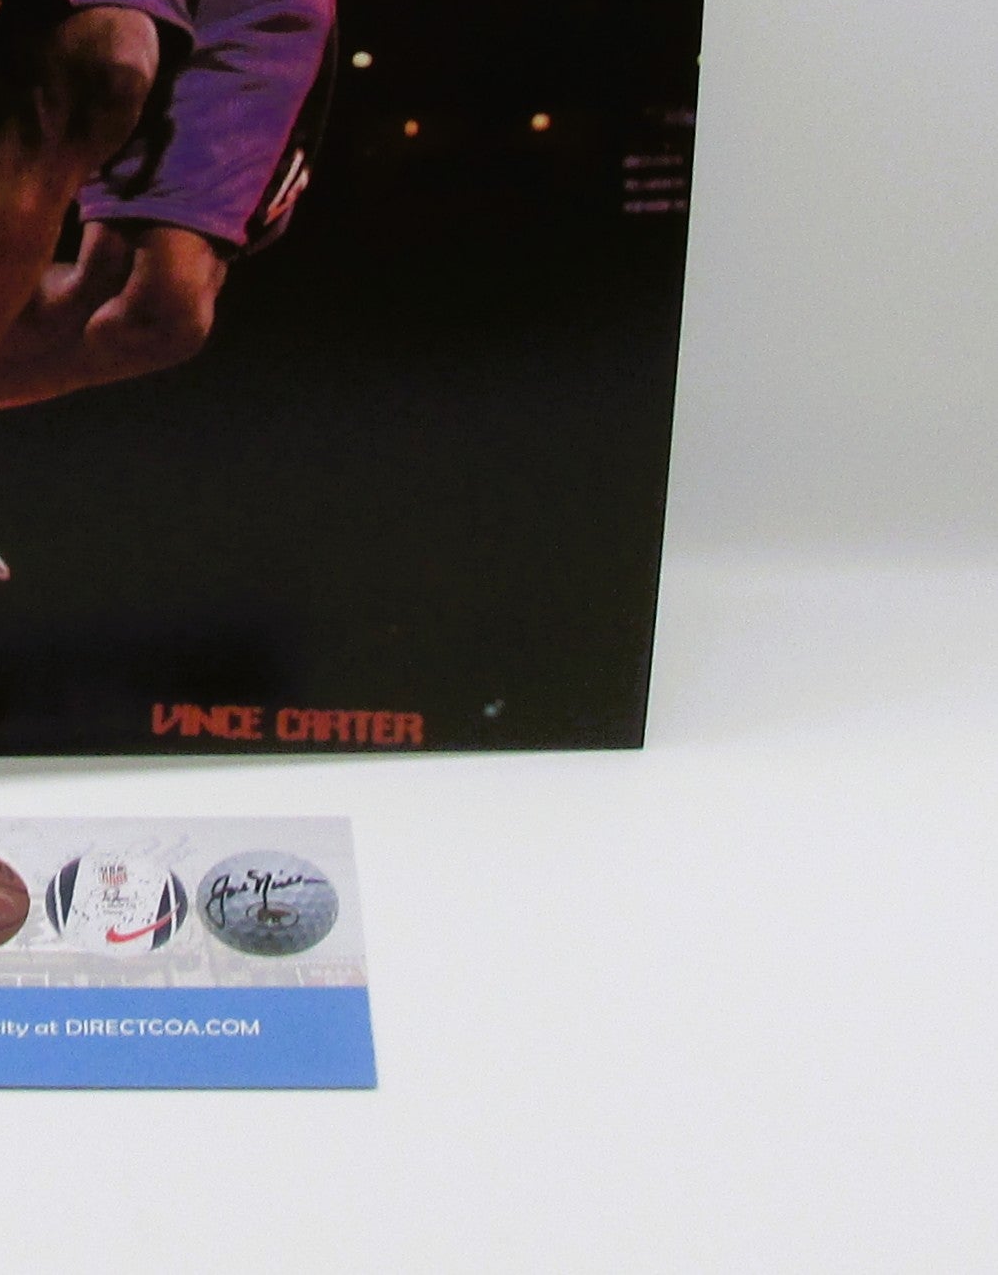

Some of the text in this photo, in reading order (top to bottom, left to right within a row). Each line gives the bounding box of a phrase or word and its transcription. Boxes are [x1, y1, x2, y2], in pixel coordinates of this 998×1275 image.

[151, 703, 424, 746] VINCE CARTER
[34, 1020, 59, 1037] at
[65, 1018, 261, 1037] DIRECTCOA.COM
